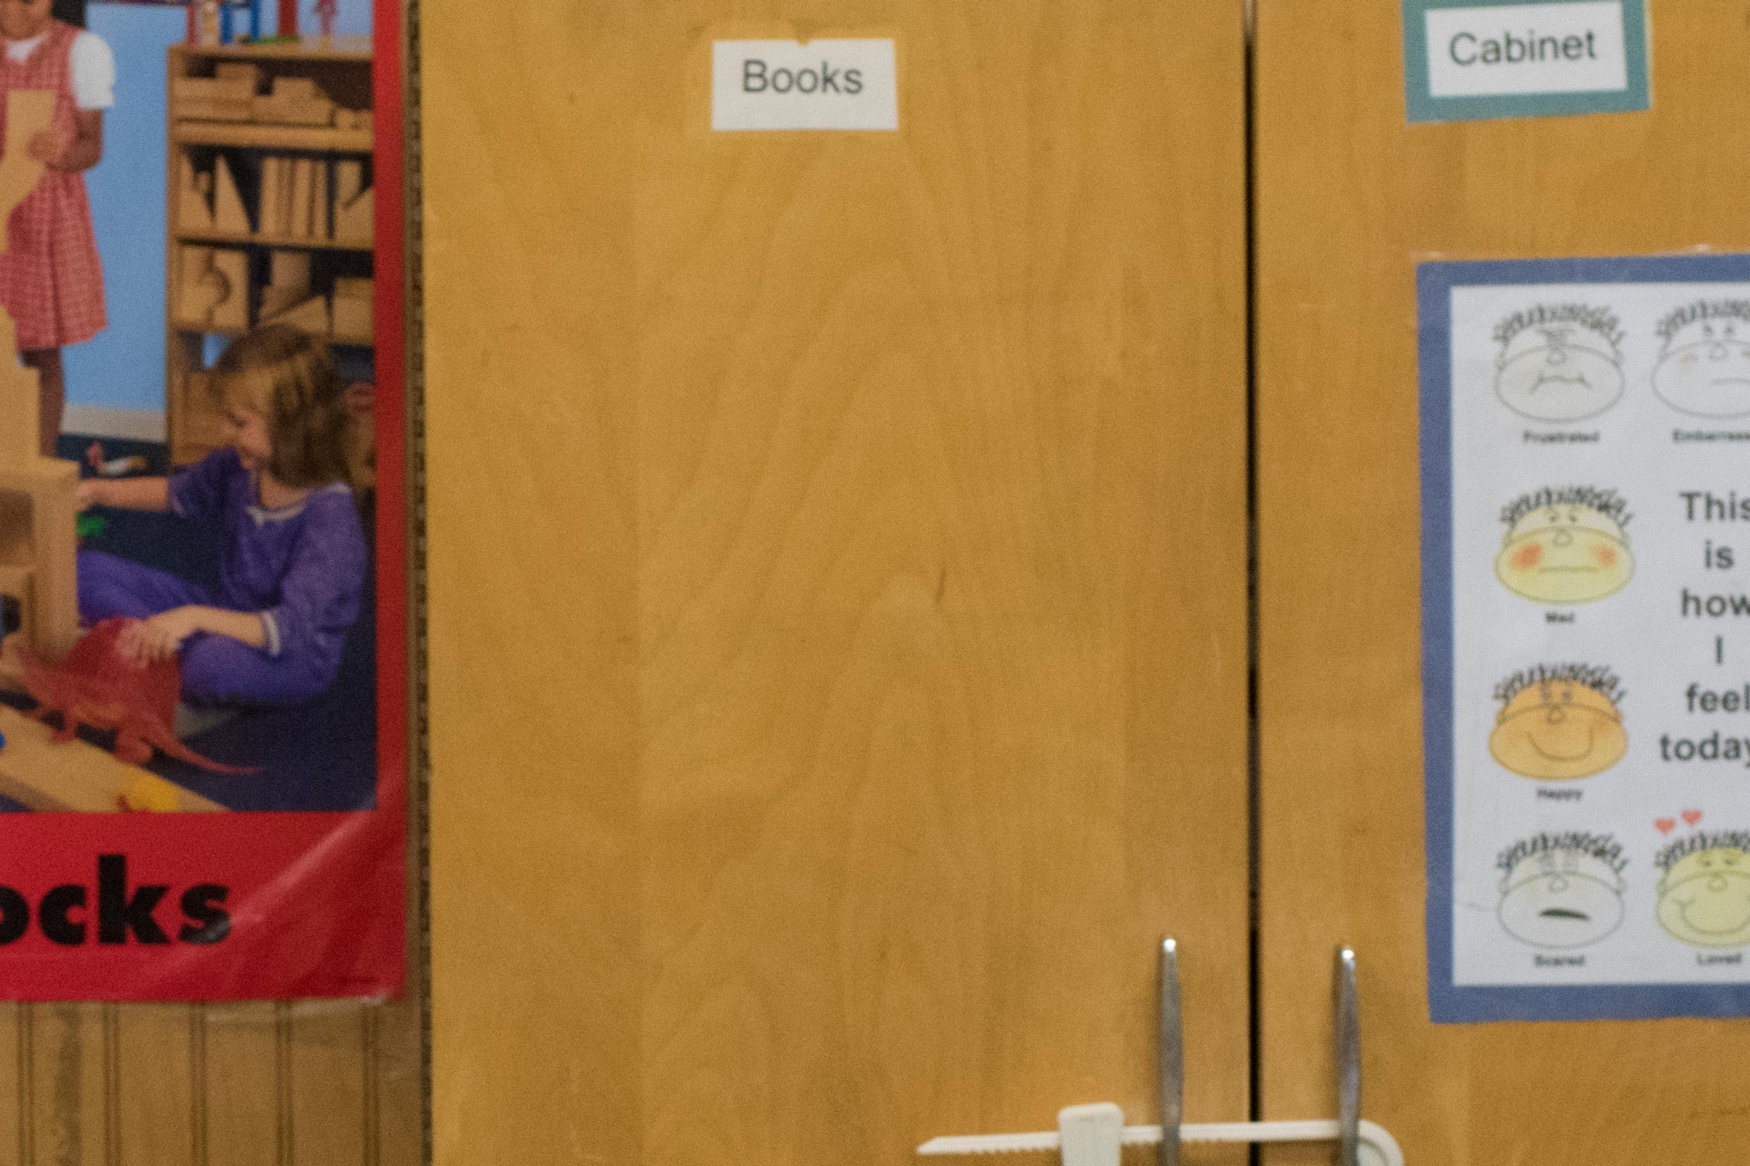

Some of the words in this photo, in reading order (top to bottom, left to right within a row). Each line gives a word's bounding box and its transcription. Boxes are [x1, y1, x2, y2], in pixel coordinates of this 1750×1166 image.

[1450, 29, 1597, 66] Cabinet
[743, 58, 863, 94] Books
[1704, 540, 1734, 569] is
[1681, 588, 1750, 618] how
[1716, 635, 1723, 664] I
[1686, 683, 1750, 713] feel
[1537, 788, 1583, 802] Happy
[1534, 954, 1586, 967] Scared
